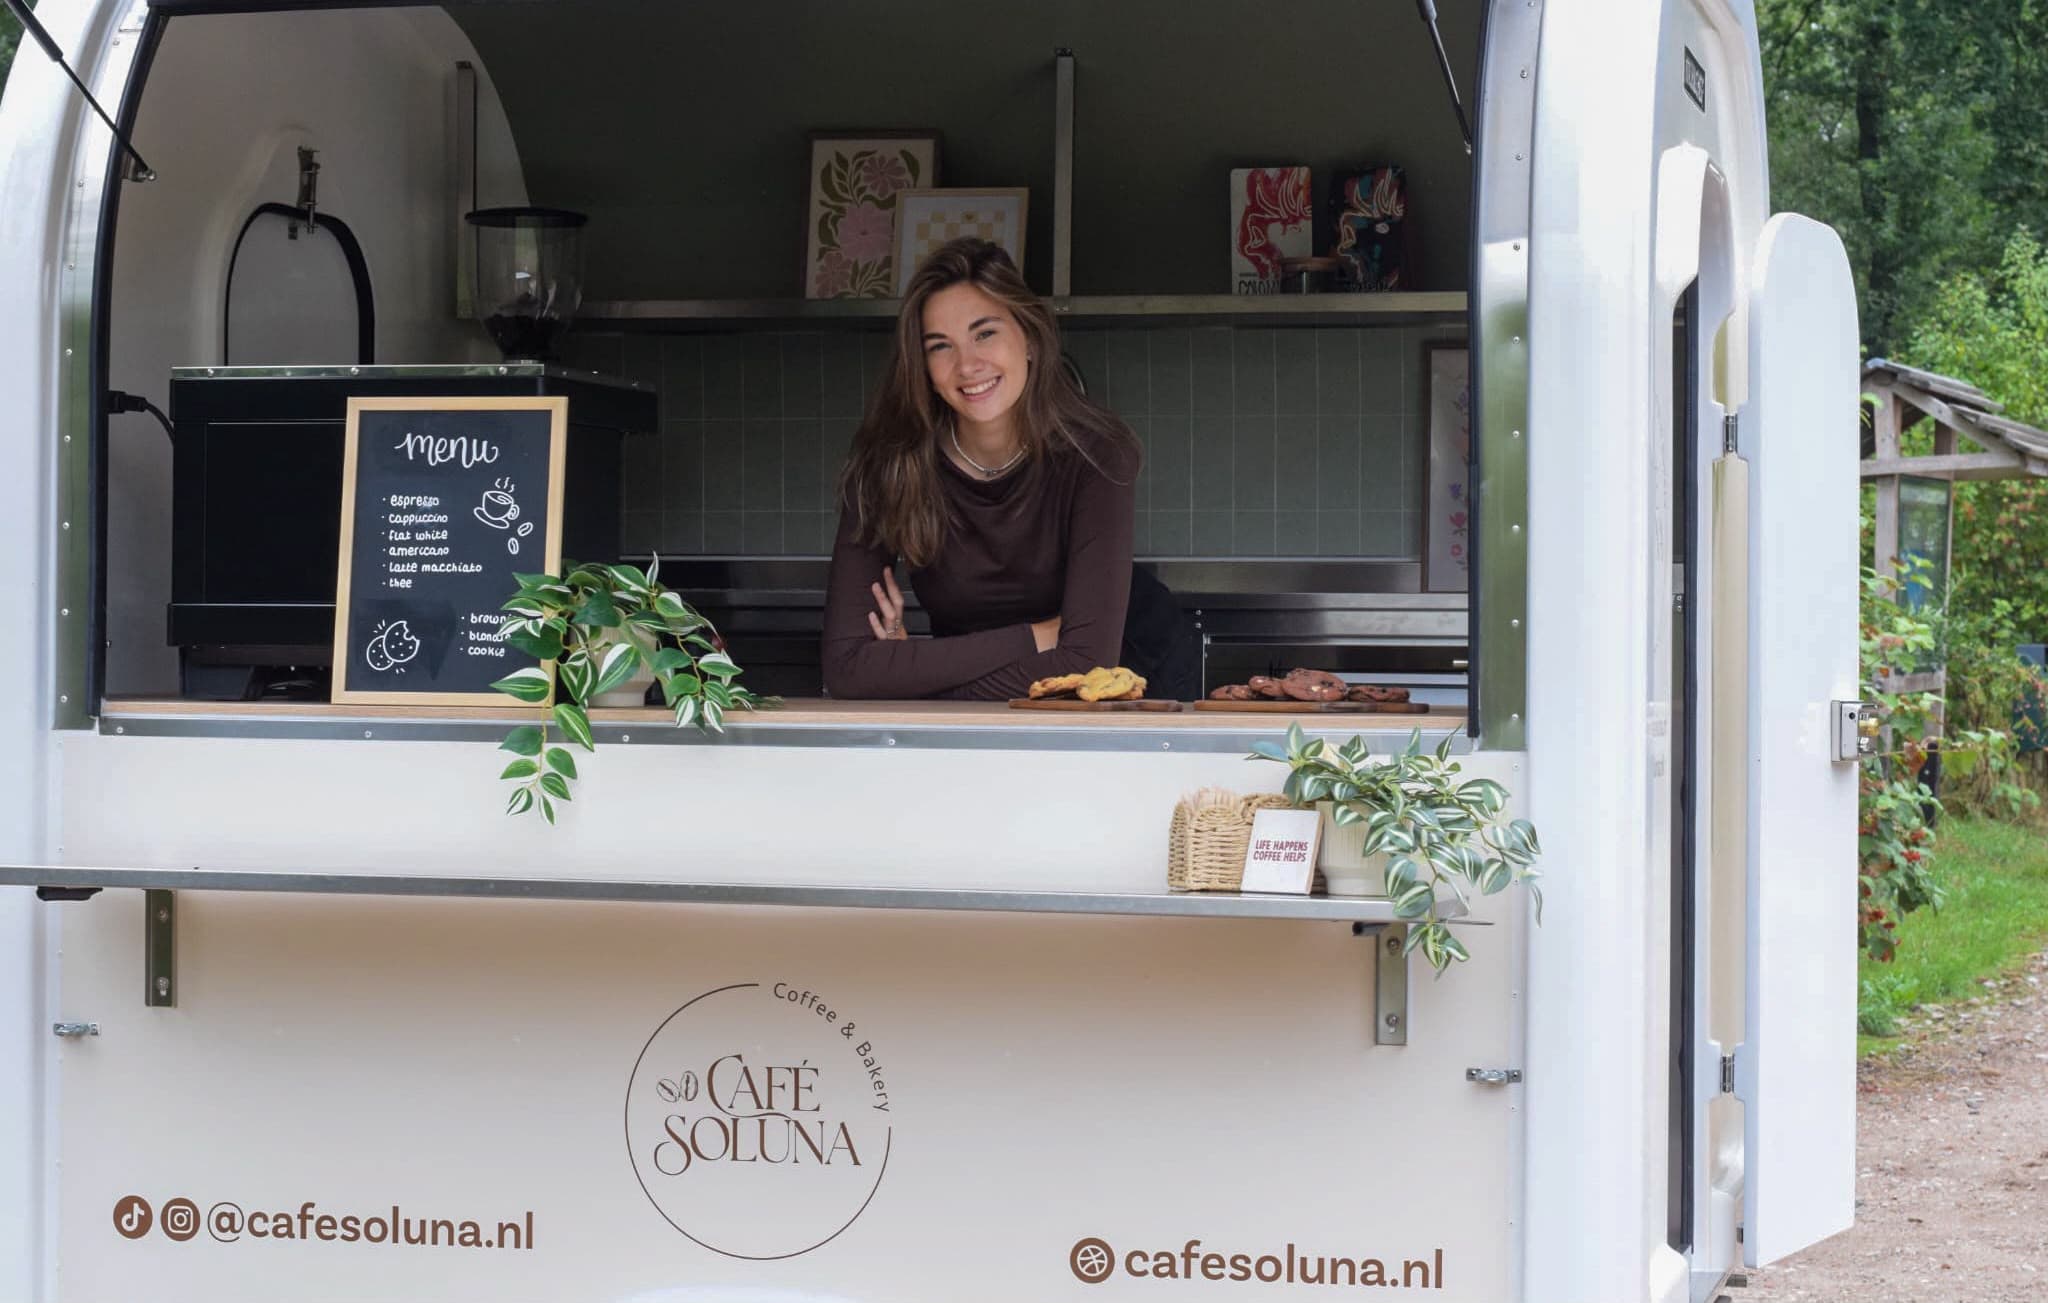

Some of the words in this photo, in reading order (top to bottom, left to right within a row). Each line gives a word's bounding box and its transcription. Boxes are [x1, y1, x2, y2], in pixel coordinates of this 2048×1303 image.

[394, 432, 499, 468] menu
[390, 494, 440, 510] espresso
[388, 513, 449, 527] cappuccino
[388, 529, 412, 541] flat
[415, 529, 448, 541] white
[388, 546, 450, 557] americano
[389, 561, 418, 573] latte
[421, 562, 483, 573] macchiato
[389, 577, 413, 588] thee
[1255, 839, 1272, 850] LIFE
[1273, 840, 1308, 851] HAPPENS
[1253, 850, 1282, 861] COFFEE
[1283, 851, 1307, 862] HELPS
[773, 982, 837, 1023] Coffee
[840, 1022, 856, 1040] &
[855, 1040, 890, 1112] Bakery
[207, 1202, 534, 1249] @cafesoluna.nl
[1125, 1240, 1443, 1289] cafesoluna.nl
